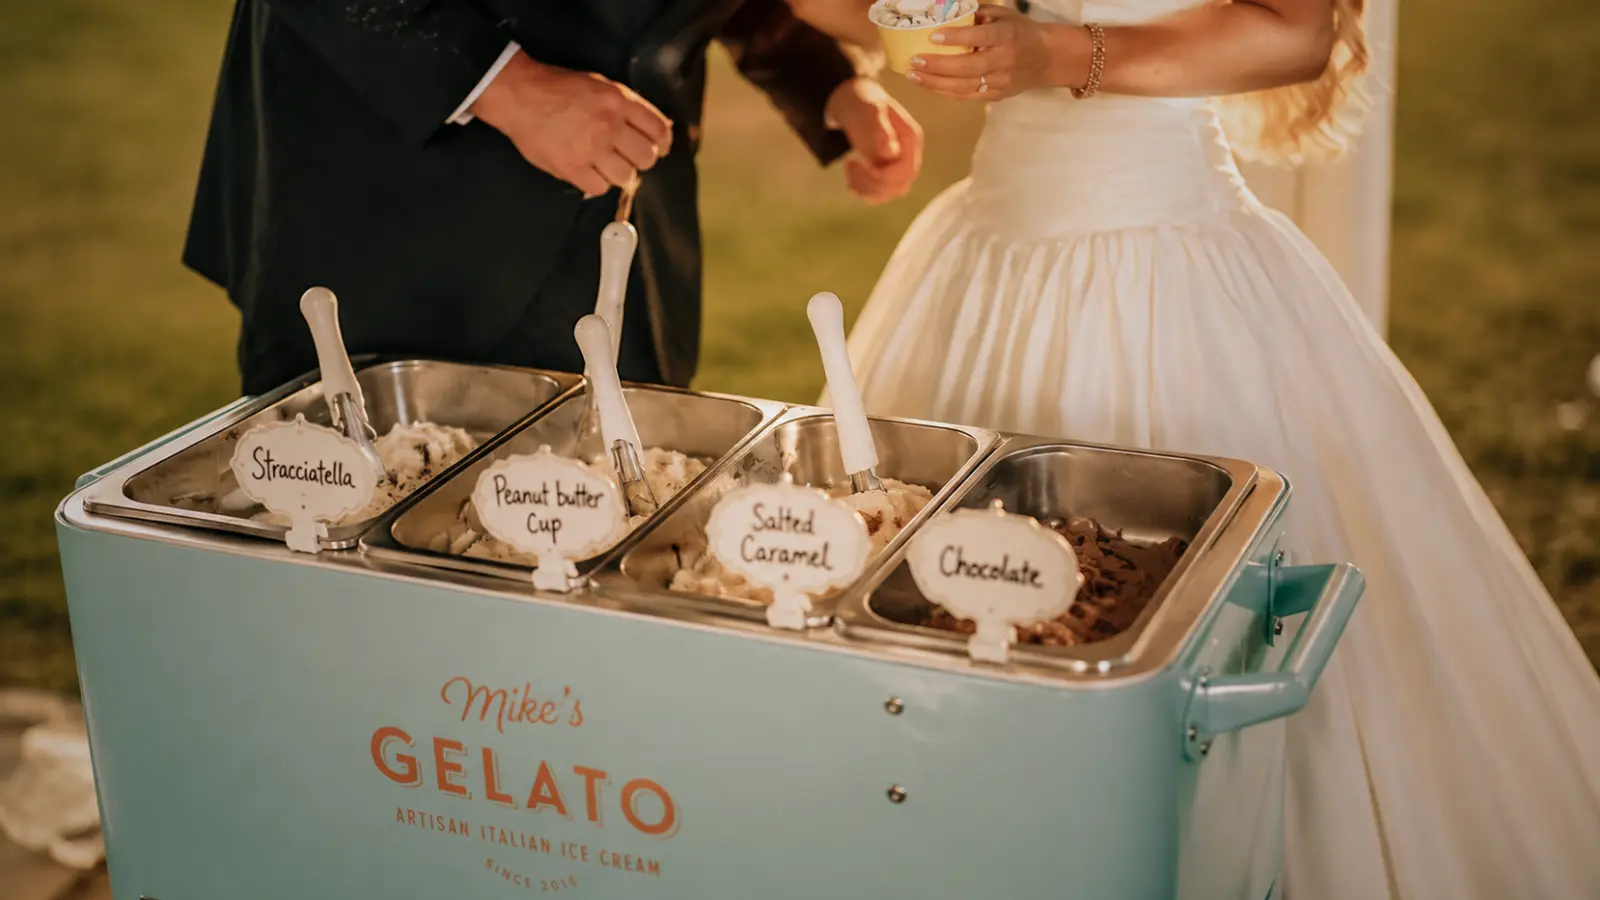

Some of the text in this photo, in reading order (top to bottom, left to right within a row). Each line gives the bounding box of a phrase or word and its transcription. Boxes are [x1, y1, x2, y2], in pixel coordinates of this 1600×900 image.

[251, 446, 356, 489] Stracciatella
[493, 474, 604, 509] Peanut butter
[526, 513, 563, 544] Cup
[751, 502, 816, 535] Salted
[740, 535, 834, 570] Caramel
[939, 545, 1045, 588] Chocolate
[441, 676, 584, 734] Mike's
[370, 726, 680, 838] GELATO
[396, 807, 661, 876] ARTISAN ITALIAN ICE CREAM
[484, 857, 532, 890] SINCE
